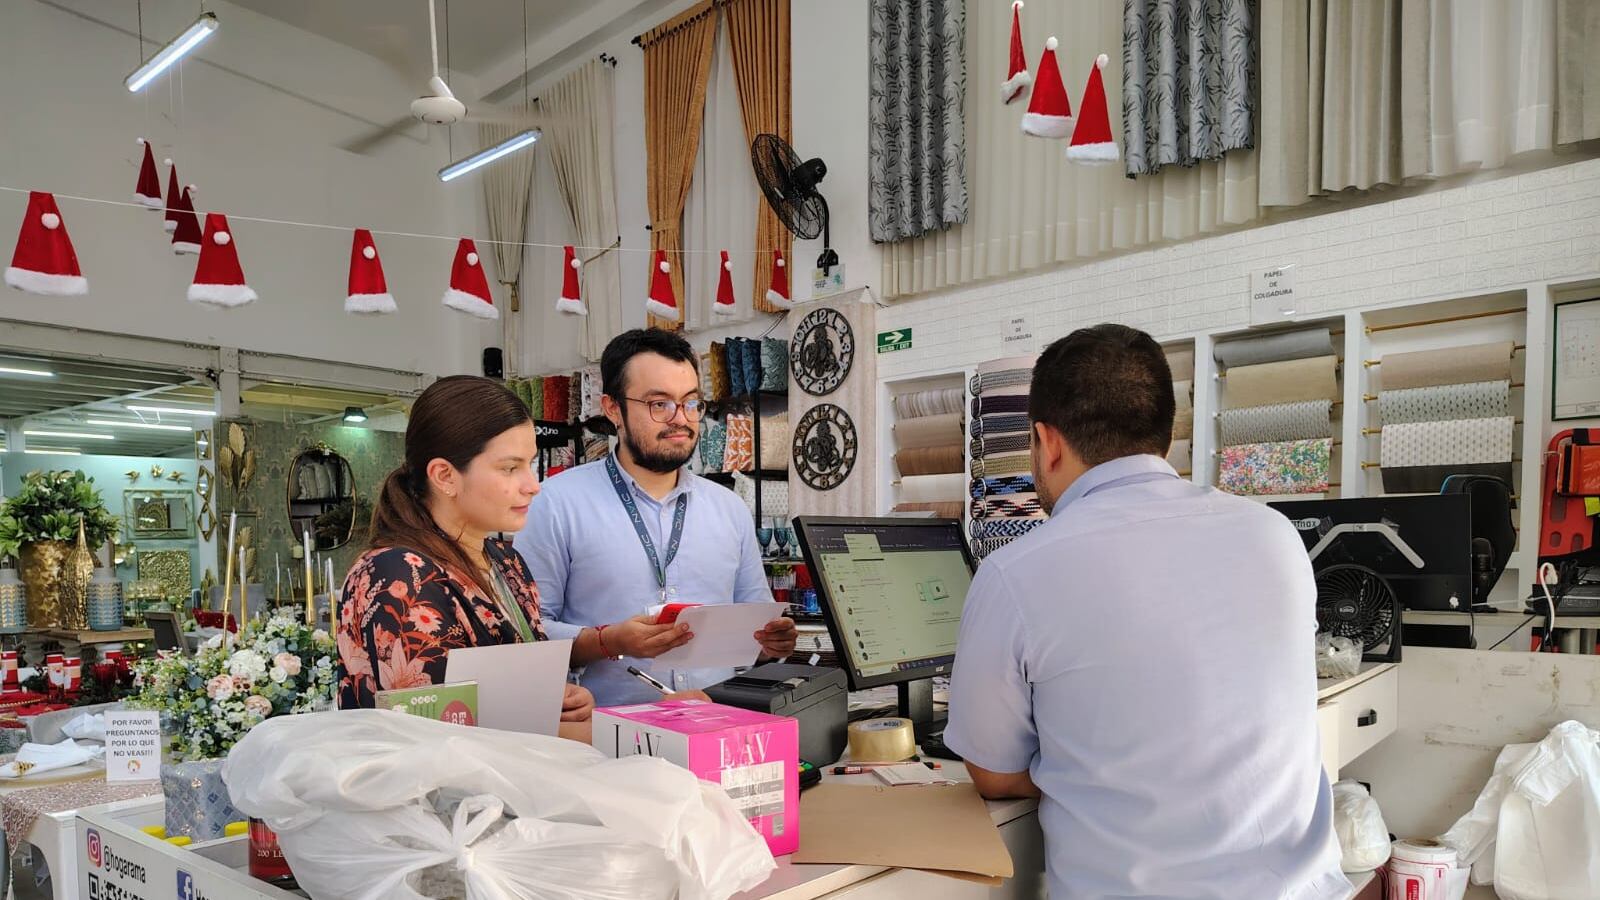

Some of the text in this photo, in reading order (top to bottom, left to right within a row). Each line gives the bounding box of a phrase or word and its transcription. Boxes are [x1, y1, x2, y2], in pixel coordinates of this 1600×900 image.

[1254, 289, 1292, 299] COLGADURA
[621, 493, 641, 523] DIAN
[104, 845, 146, 883] @hogarama
